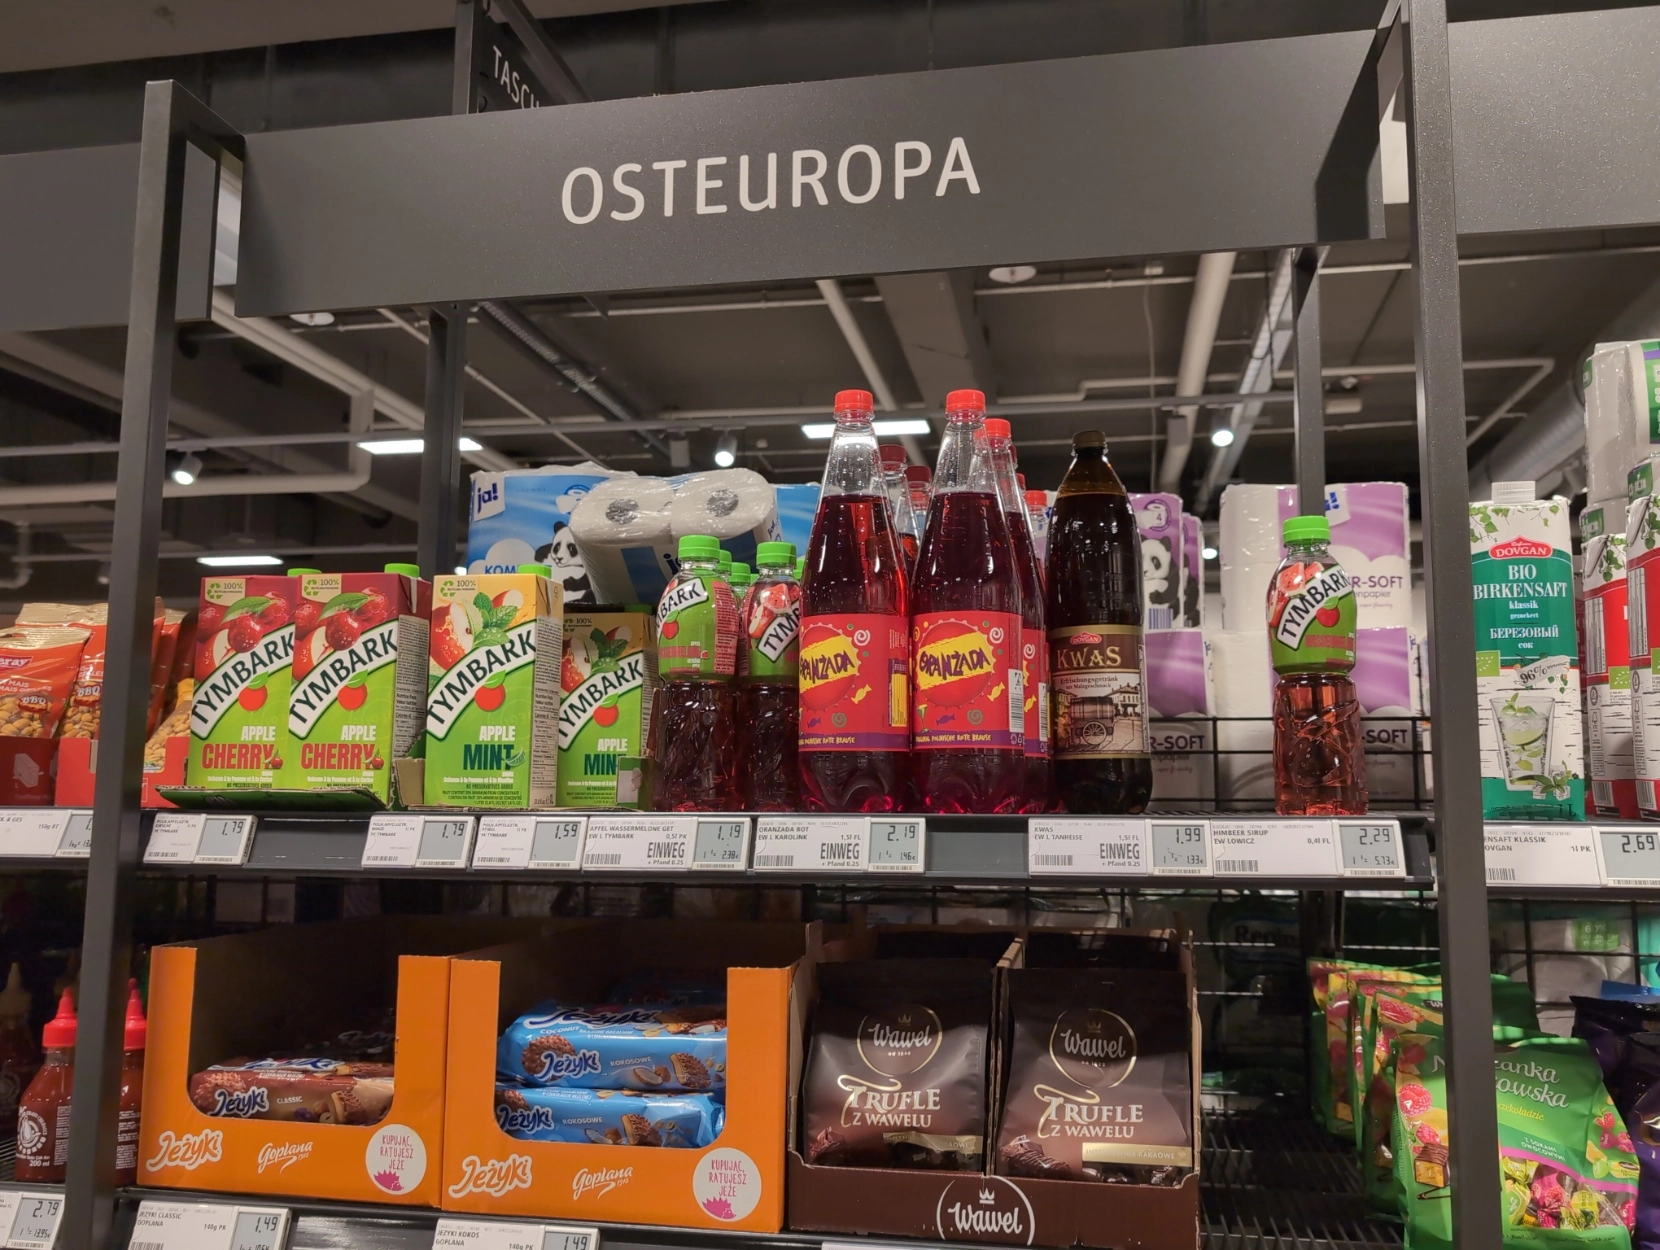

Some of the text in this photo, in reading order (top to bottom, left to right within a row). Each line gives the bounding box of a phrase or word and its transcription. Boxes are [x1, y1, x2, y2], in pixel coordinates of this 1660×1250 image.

[560, 137, 981, 225] OSTEUROPA
[477, 483, 499, 514] ja!
[1495, 546, 1548, 558] DOVGAN
[1507, 563, 1537, 581] BIO
[320, 578, 339, 586] 100%
[1472, 582, 1568, 600] BIRKENSAFT
[1280, 569, 1351, 639] TYMBARK
[1508, 600, 1539, 609] klassik
[1489, 624, 1559, 639] БЕРЕЗОВЫЙ
[1057, 645, 1122, 669] KWAS
[191, 631, 294, 725] TYMBARK
[289, 628, 398, 725] TYMBARK
[427, 629, 537, 725] TYMBARK
[1519, 665, 1548, 685] 96%
[77, 685, 100, 697] BBQ
[21, 696, 47, 705] BBQ
[240, 725, 276, 741] APPLE
[340, 725, 376, 741] APPLE
[479, 725, 516, 741] APPLE
[972, 733, 992, 741] BRAUSE
[597, 738, 628, 752] APPLE
[201, 742, 275, 770] CHERRY
[300, 742, 376, 770] CHERRY
[463, 743, 515, 771] MINT
[584, 753, 627, 776] MIN
[221, 821, 244, 836] 1.79
[441, 823, 465, 839] 1.79
[554, 823, 578, 839] 1.59
[717, 825, 741, 841] 1.19
[887, 825, 916, 841] 2.19
[1176, 828, 1201, 844] 1.99
[1359, 828, 1390, 845] 2.29
[647, 841, 686, 858] EINWEG
[820, 842, 860, 860] EINWEG
[1100, 843, 1140, 860] EINWEG
[1621, 835, 1655, 853] 2.69
[540, 1025, 580, 1035] COCONUT
[868, 1022, 932, 1048] Wawel
[1060, 1028, 1127, 1059] Wawel
[536, 1050, 602, 1082] Jeżyki
[609, 1056, 653, 1067] KOKOSOWE
[210, 1086, 269, 1117] Jeżyki
[276, 1096, 303, 1105] CLASSIC
[840, 1076, 941, 1115] TRUFLE
[1037, 1088, 1144, 1126] TRUFLE
[497, 1105, 555, 1135] Jeżyki
[562, 1116, 604, 1125] KOKOSOWE
[852, 1112, 932, 1127] Z WAWELU
[1051, 1125, 1135, 1138] Z WAWELU
[147, 1129, 223, 1172] Jeżyki
[258, 1142, 313, 1174] Goplana
[379, 1145, 414, 1159] RATUJESZ
[388, 1158, 405, 1171] JEŻE
[448, 1154, 533, 1199] Jeżyki
[572, 1166, 634, 1200] Goplana
[708, 1172, 747, 1185] RATUJESZ
[718, 1183, 737, 1197] JEŻE
[32, 1200, 60, 1218] 2.79
[158, 1212, 182, 1220] CLASSIC
[137, 1219, 164, 1227] GOPLANA
[255, 1216, 278, 1234] 1.49
[948, 1202, 1023, 1235] Wawel
[435, 1238, 465, 1247] GOPLANA
[458, 1230, 480, 1239] KOKOS
